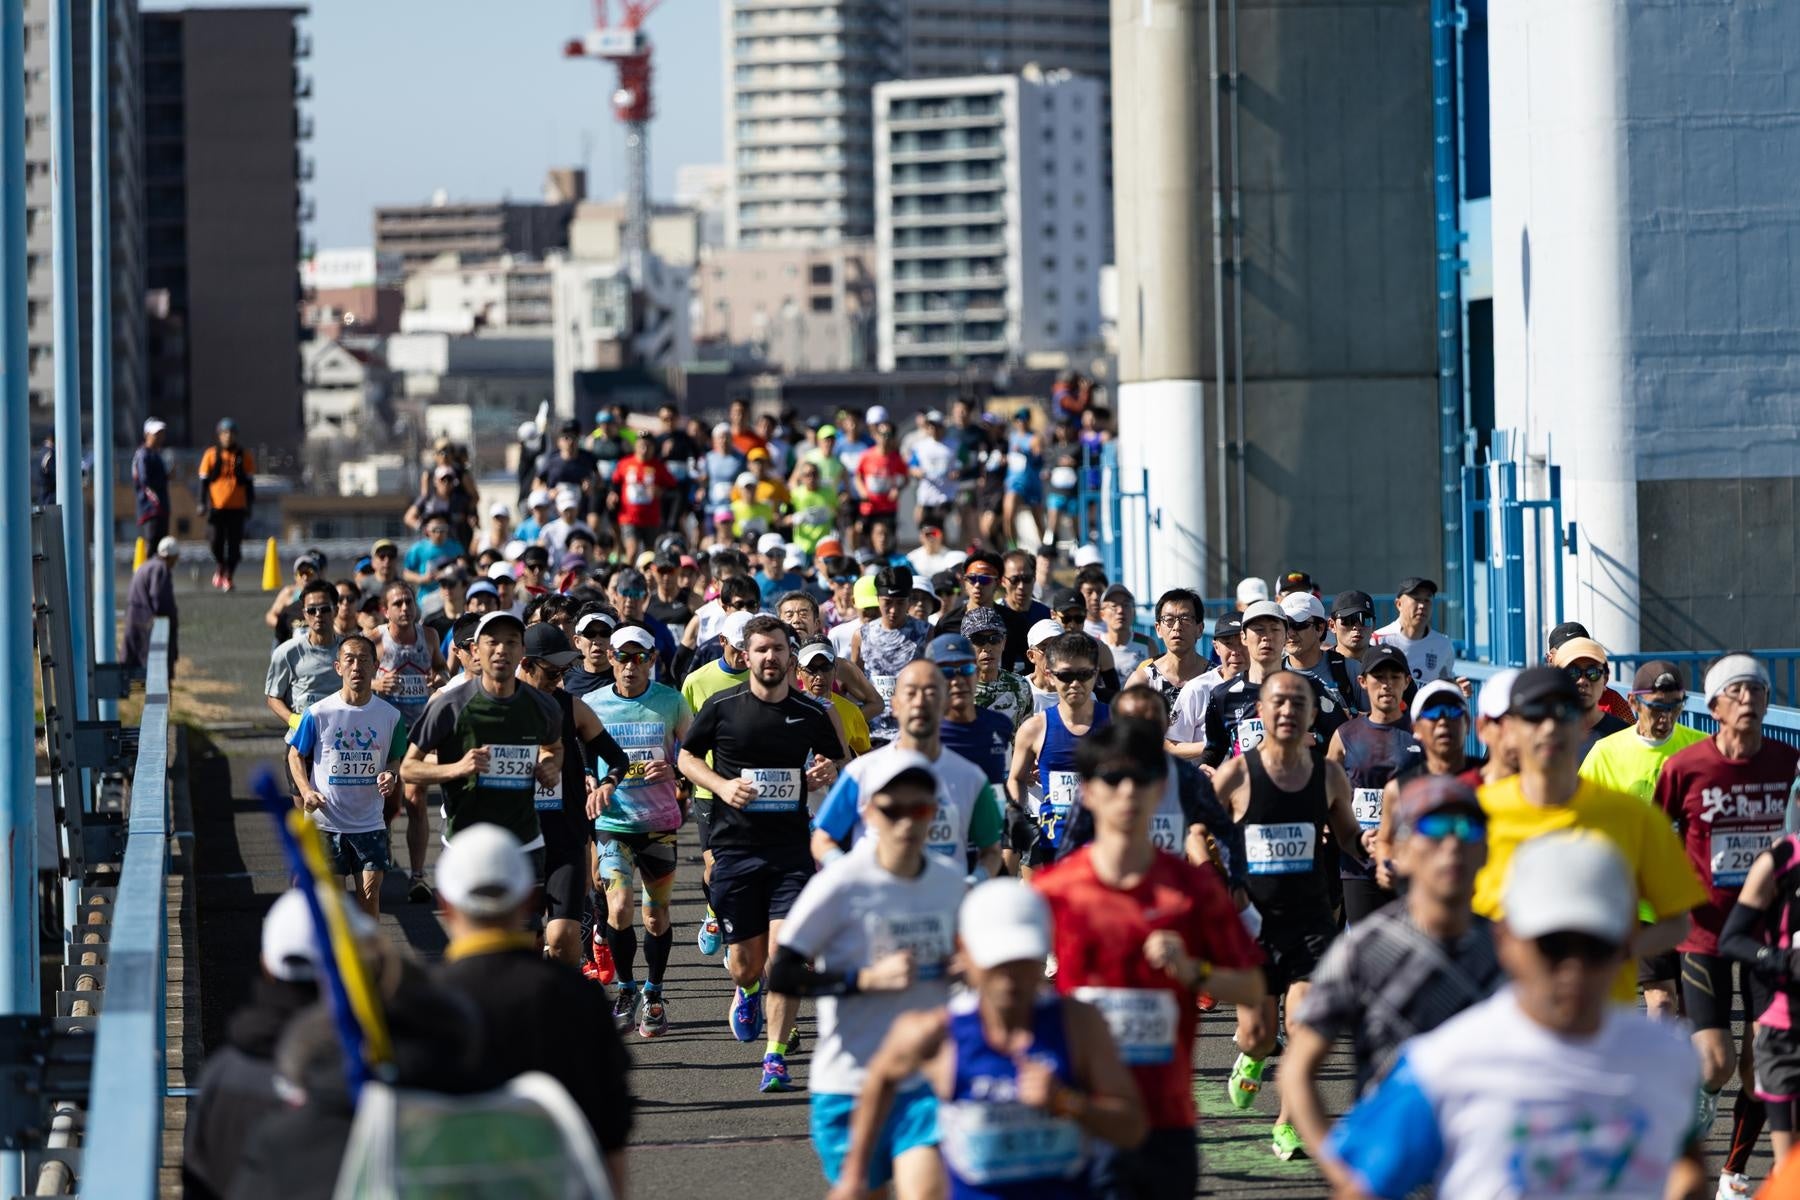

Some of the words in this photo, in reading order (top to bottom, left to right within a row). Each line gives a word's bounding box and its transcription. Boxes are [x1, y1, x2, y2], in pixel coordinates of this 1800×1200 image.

[399, 685, 425, 696] 2488
[1242, 738, 1250, 748] C
[340, 751, 374, 762] TANITA
[493, 747, 531, 760] TANITA
[331, 765, 338, 774] C
[342, 762, 376, 775] 3176
[495, 761, 534, 775] 3528
[753, 770, 793, 782] TANITA
[536, 786, 556, 798] 48
[758, 784, 795, 798] 2267
[1052, 790, 1060, 801] B
[1355, 807, 1362, 818] B
[927, 824, 952, 841] 60
[1257, 825, 1303, 840] TANITA
[1152, 832, 1176, 850] 02
[1725, 836, 1772, 849] TANITA
[1264, 841, 1308, 858] 3007
